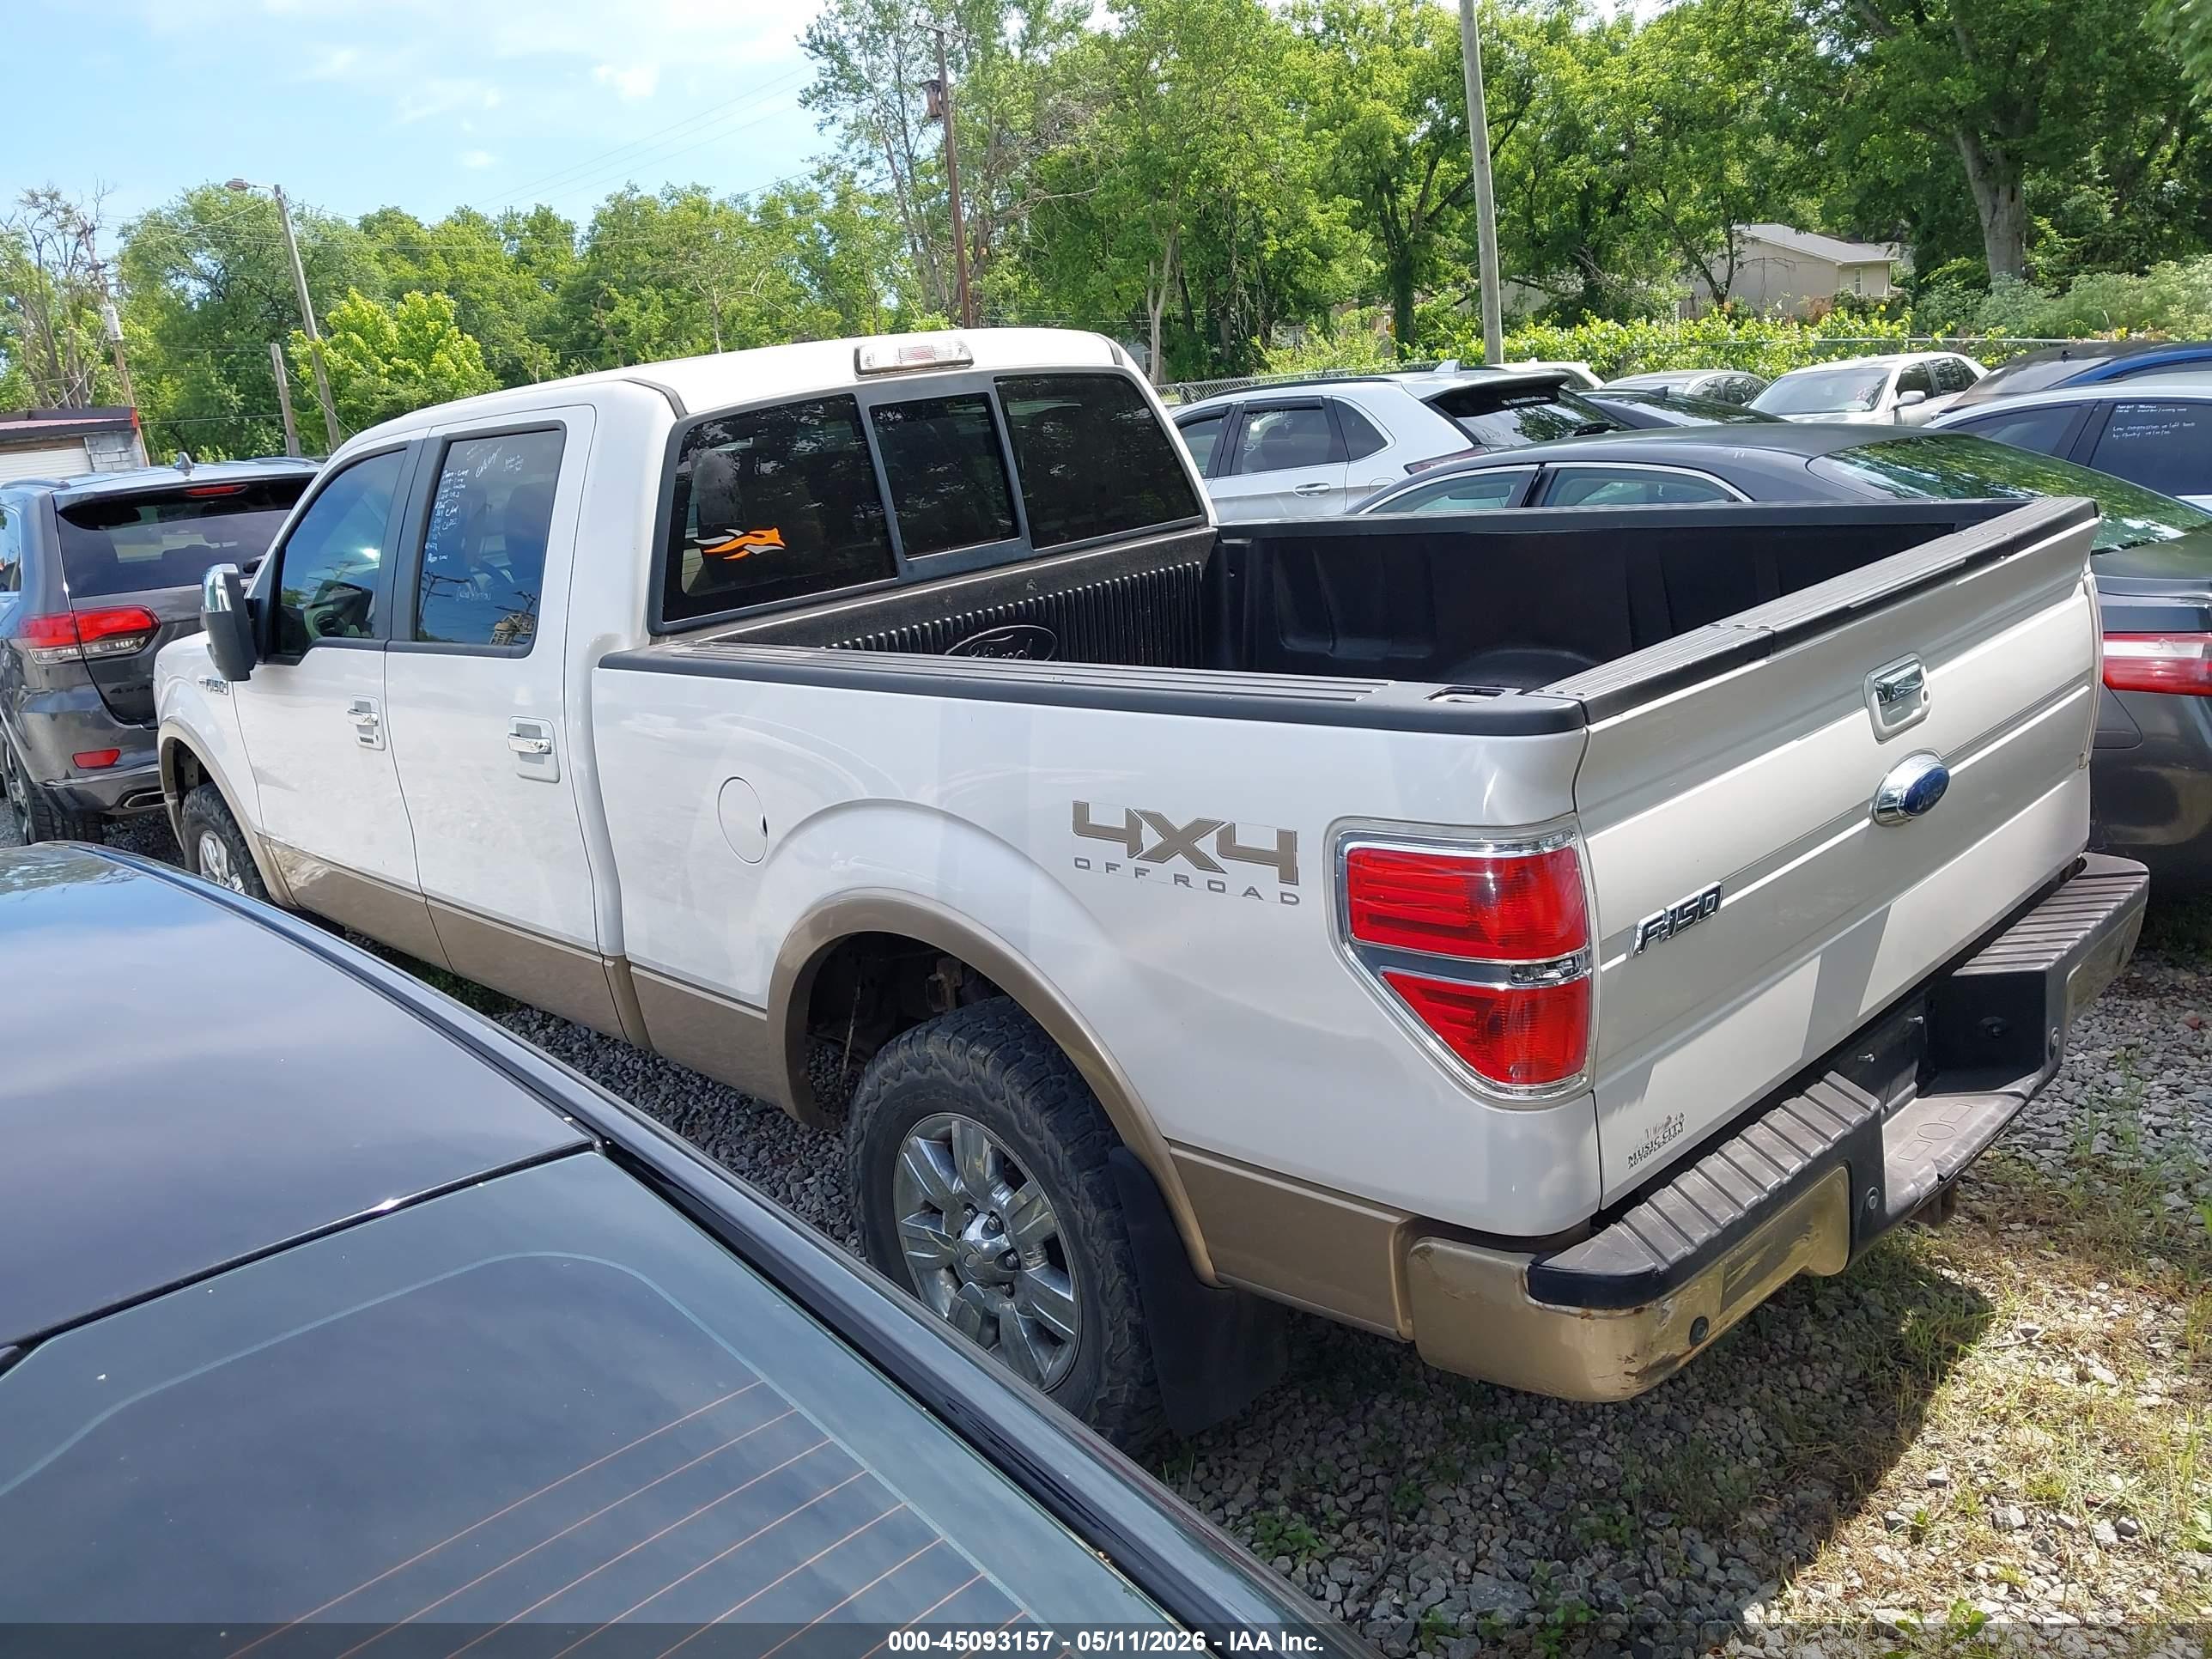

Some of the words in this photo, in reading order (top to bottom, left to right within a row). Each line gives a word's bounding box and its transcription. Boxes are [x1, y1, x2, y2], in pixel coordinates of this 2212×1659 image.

[1628, 1135, 1661, 1165] MUSIC
[1662, 1118, 1685, 1140] CITY
[1628, 1127, 1684, 1170] AUTOPLEX.COM
